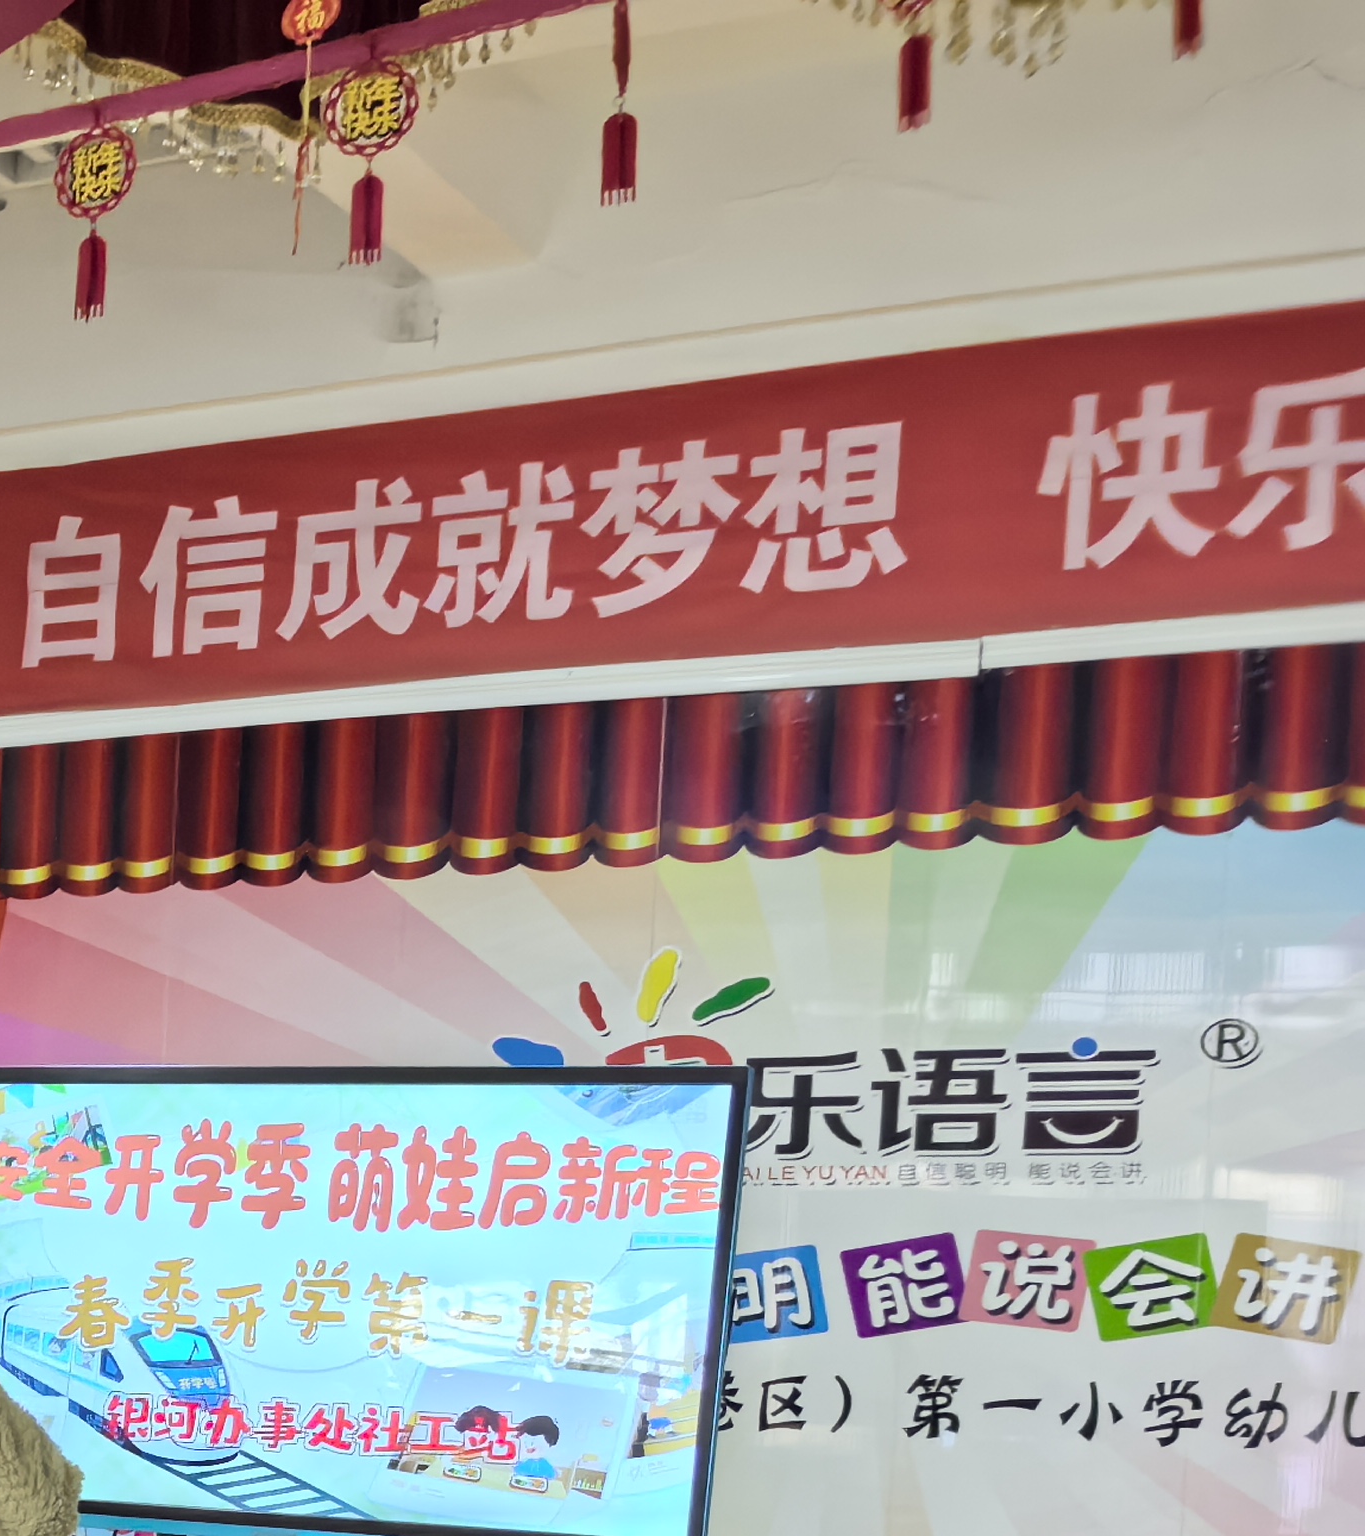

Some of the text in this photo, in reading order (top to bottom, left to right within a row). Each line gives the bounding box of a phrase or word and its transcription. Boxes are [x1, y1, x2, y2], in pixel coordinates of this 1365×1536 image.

[21, 368, 1365, 668] 自信成就梦想 快乐
[327, 1122, 721, 1233] 萌娃启新程
[768, 1166, 795, 1180] LE
[839, 1164, 888, 1180] YAN
[57, 1258, 599, 1366] 春季开学第一课
[857, 1238, 1343, 1334] 能说会讲
[103, 1396, 523, 1466] 银河办事处社工站
